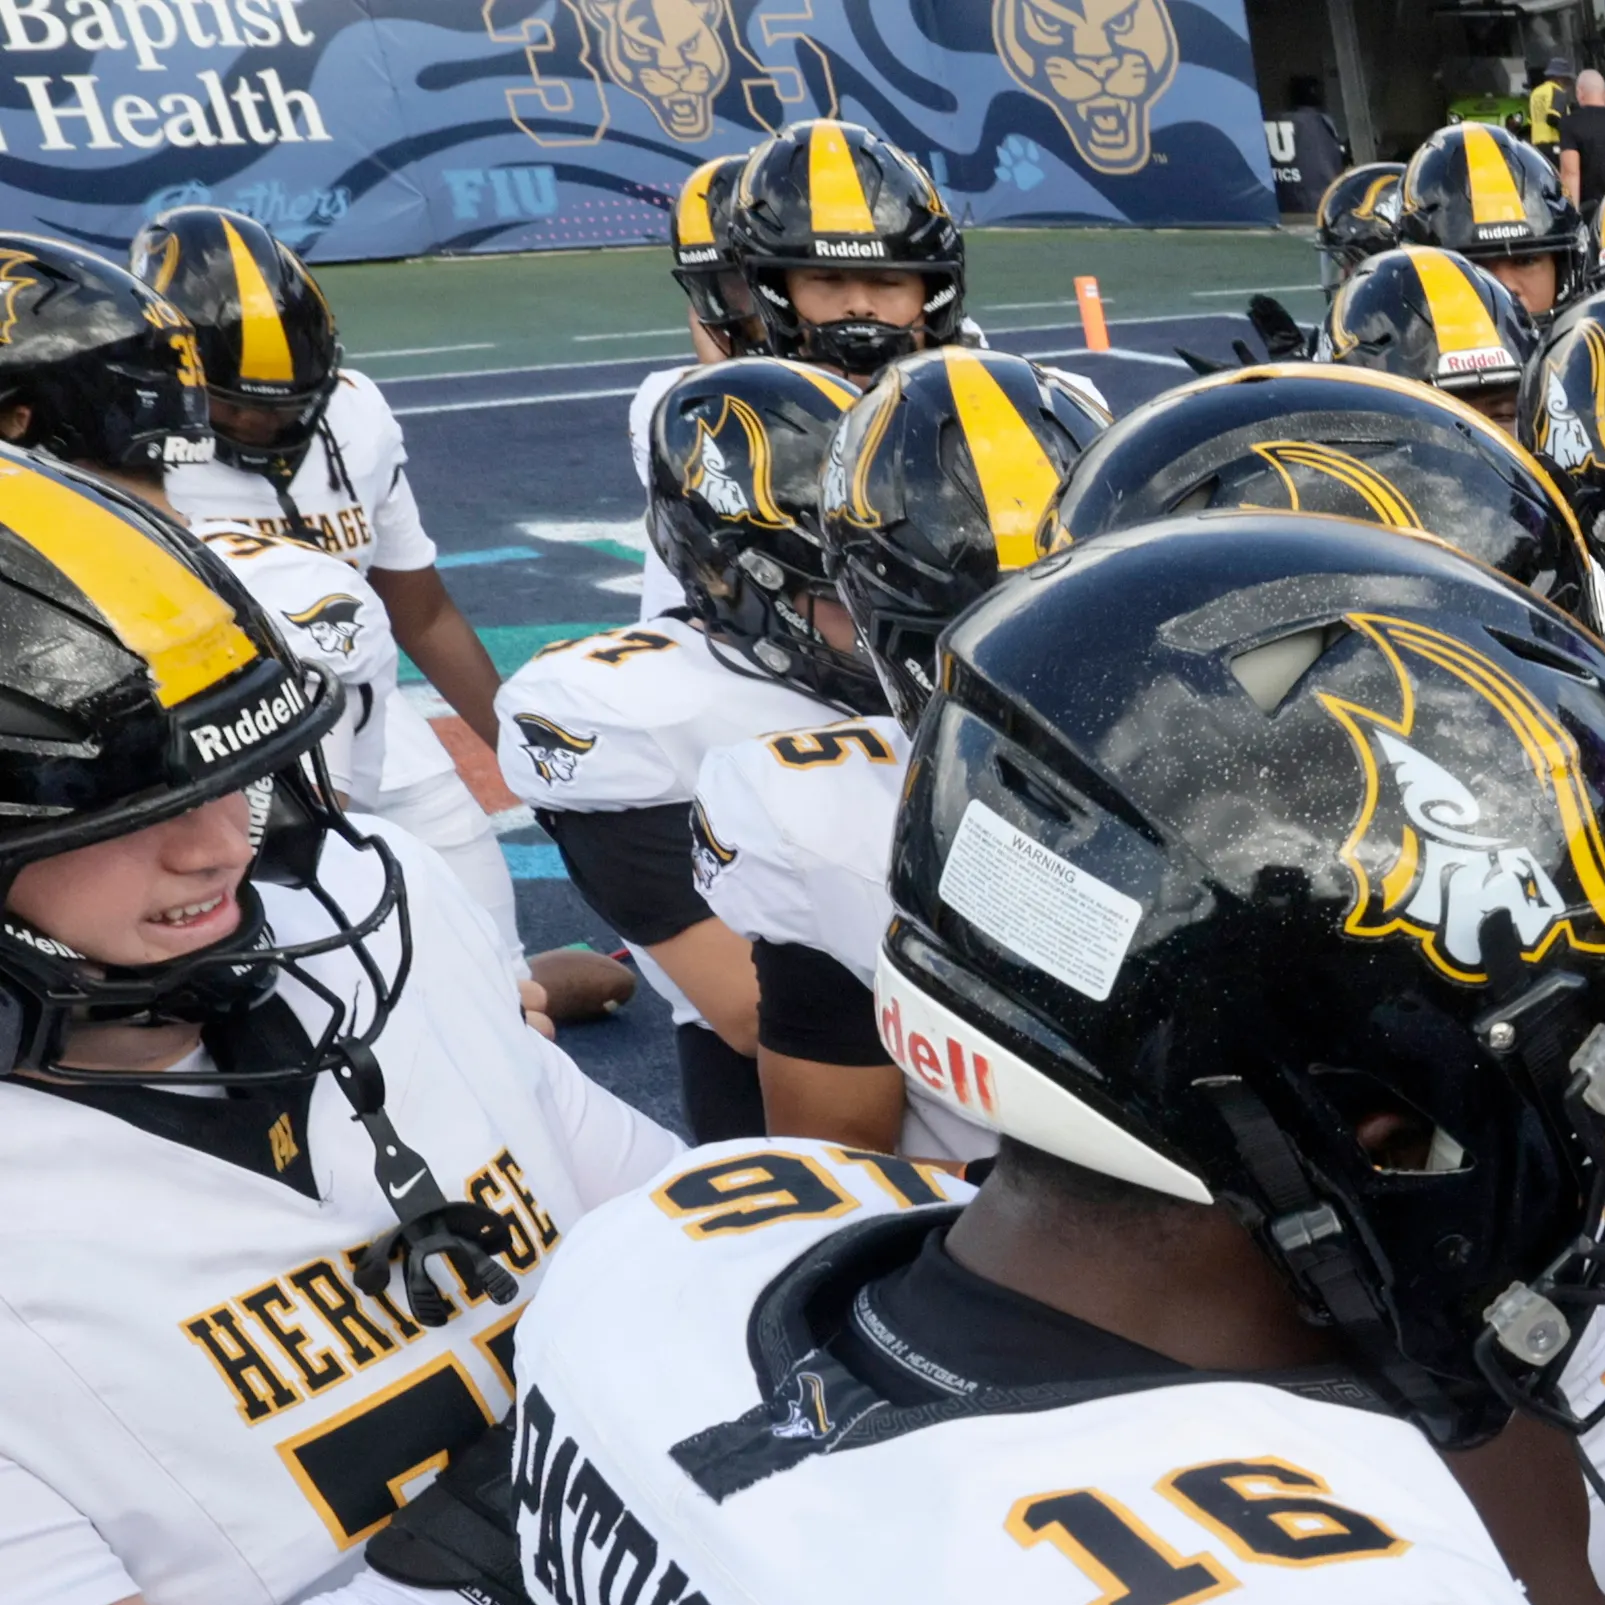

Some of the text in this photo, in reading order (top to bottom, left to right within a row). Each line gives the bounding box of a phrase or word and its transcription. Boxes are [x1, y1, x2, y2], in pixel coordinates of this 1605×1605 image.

[14, 68, 334, 151] Health
[441, 166, 558, 221] FIU
[815, 239, 884, 258] Riddell
[1448, 350, 1507, 372] Riddell
[190, 677, 305, 764] Riddell
[1011, 833, 1077, 886] WARNING
